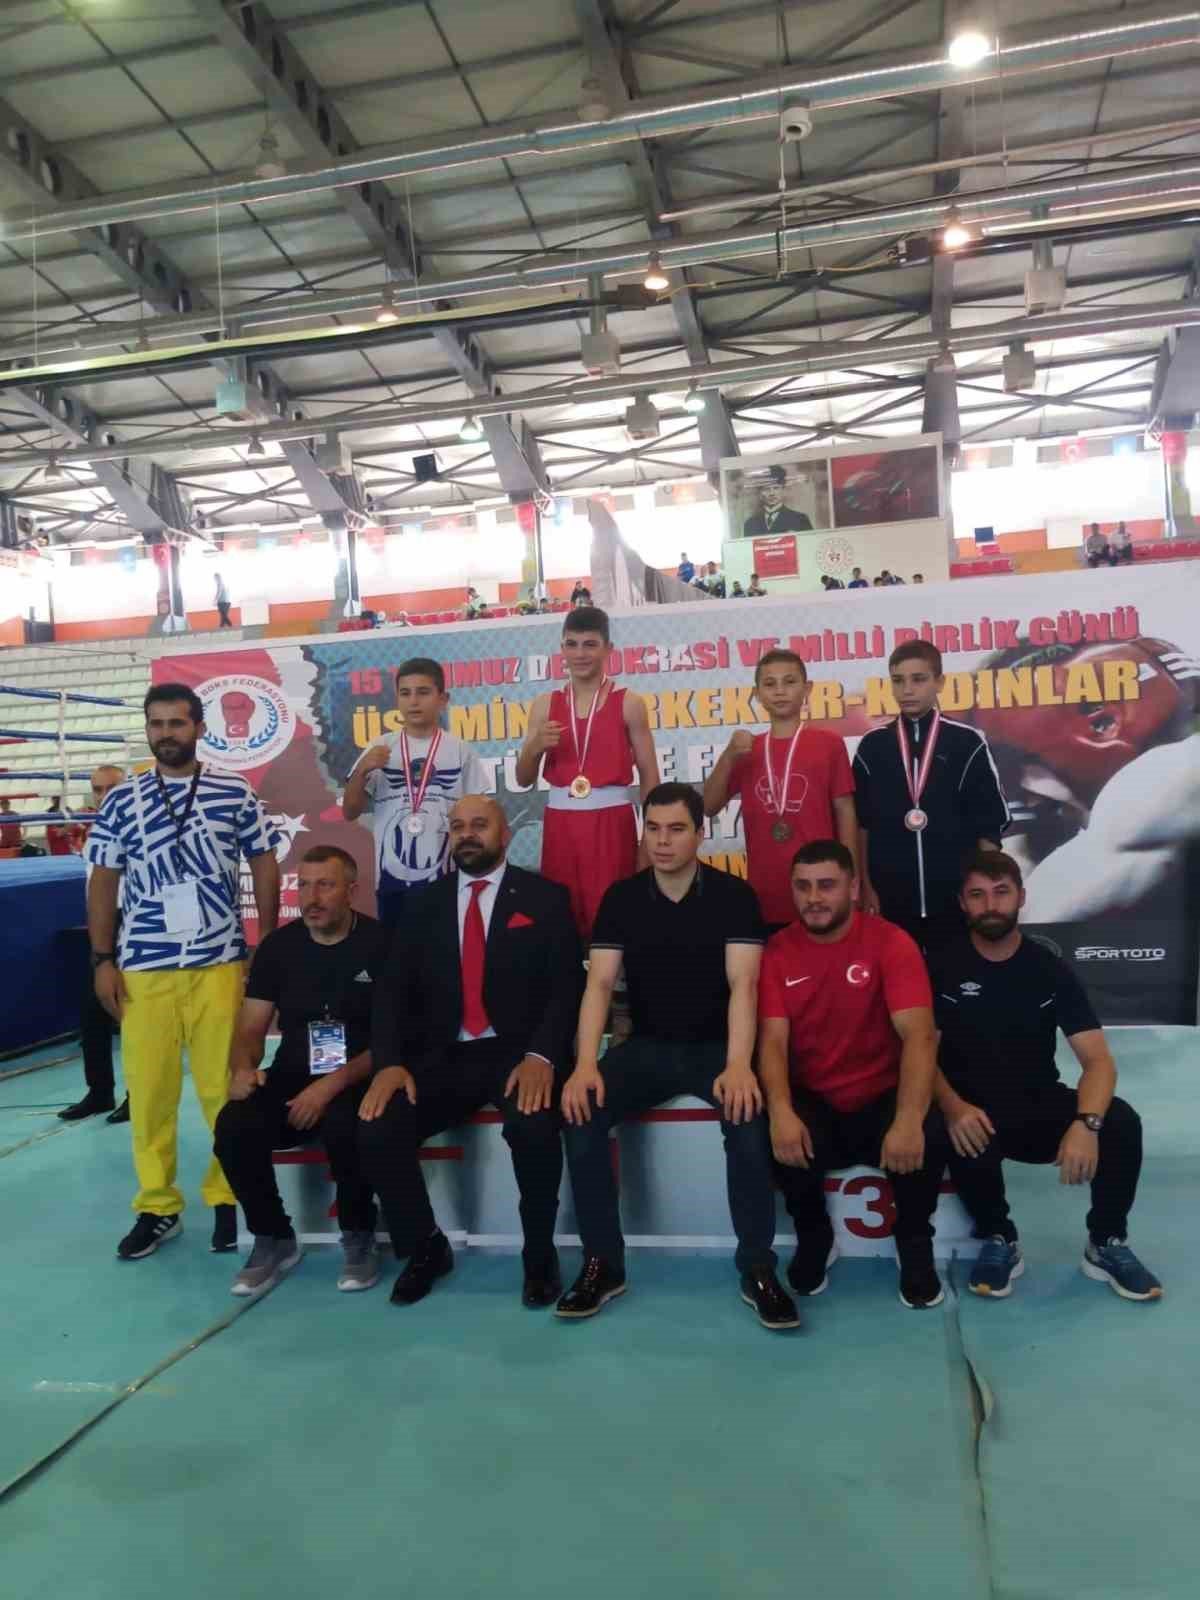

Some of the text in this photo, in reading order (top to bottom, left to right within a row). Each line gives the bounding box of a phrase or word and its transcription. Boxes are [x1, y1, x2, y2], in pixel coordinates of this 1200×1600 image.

[351, 669, 382, 695] 15
[790, 625, 885, 663] MİLLİ
[1029, 605, 1140, 646] GÜNÜ
[843, 1175, 897, 1239] 3
